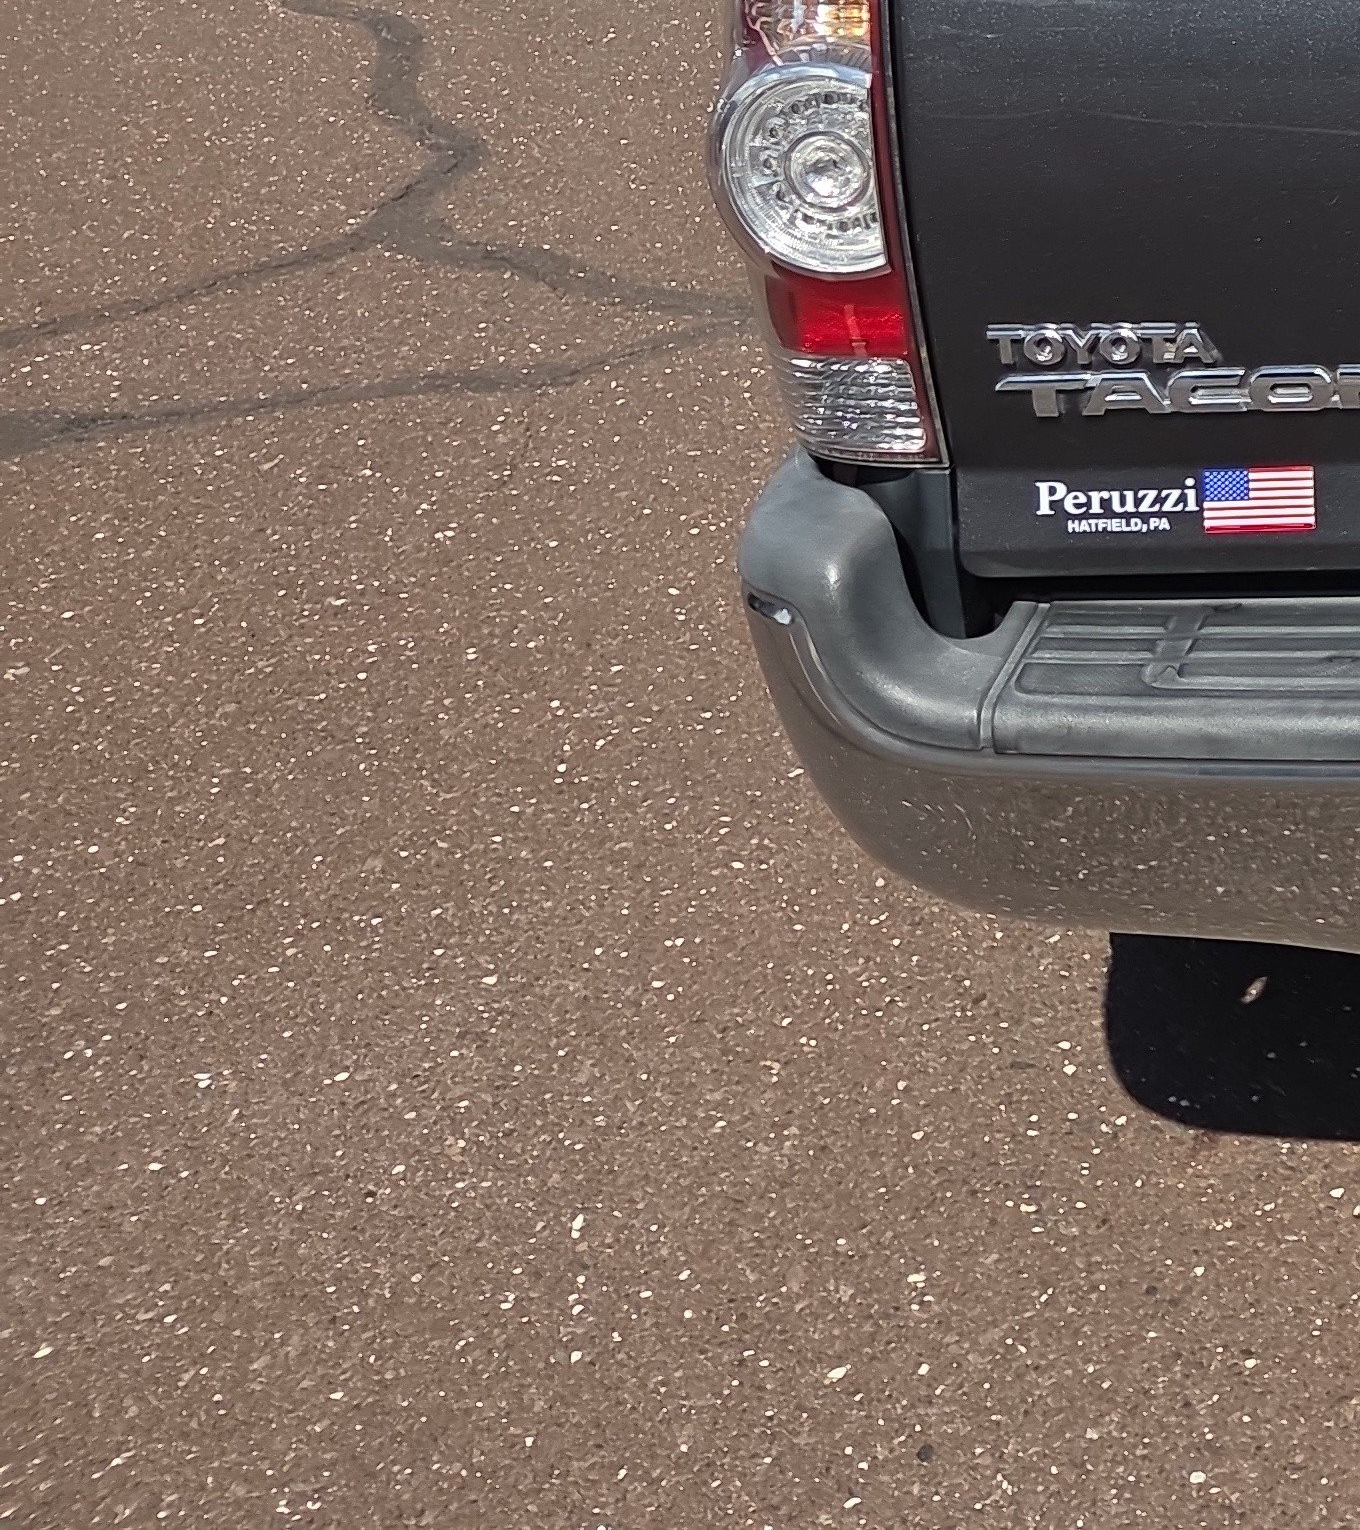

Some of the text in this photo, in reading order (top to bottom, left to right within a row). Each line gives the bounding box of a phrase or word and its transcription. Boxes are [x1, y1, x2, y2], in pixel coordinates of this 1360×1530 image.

[986, 323, 1219, 365] TOYOTA
[1035, 477, 1200, 516] Peruzzi
[1067, 517, 1171, 533] HATFIELD, PA
